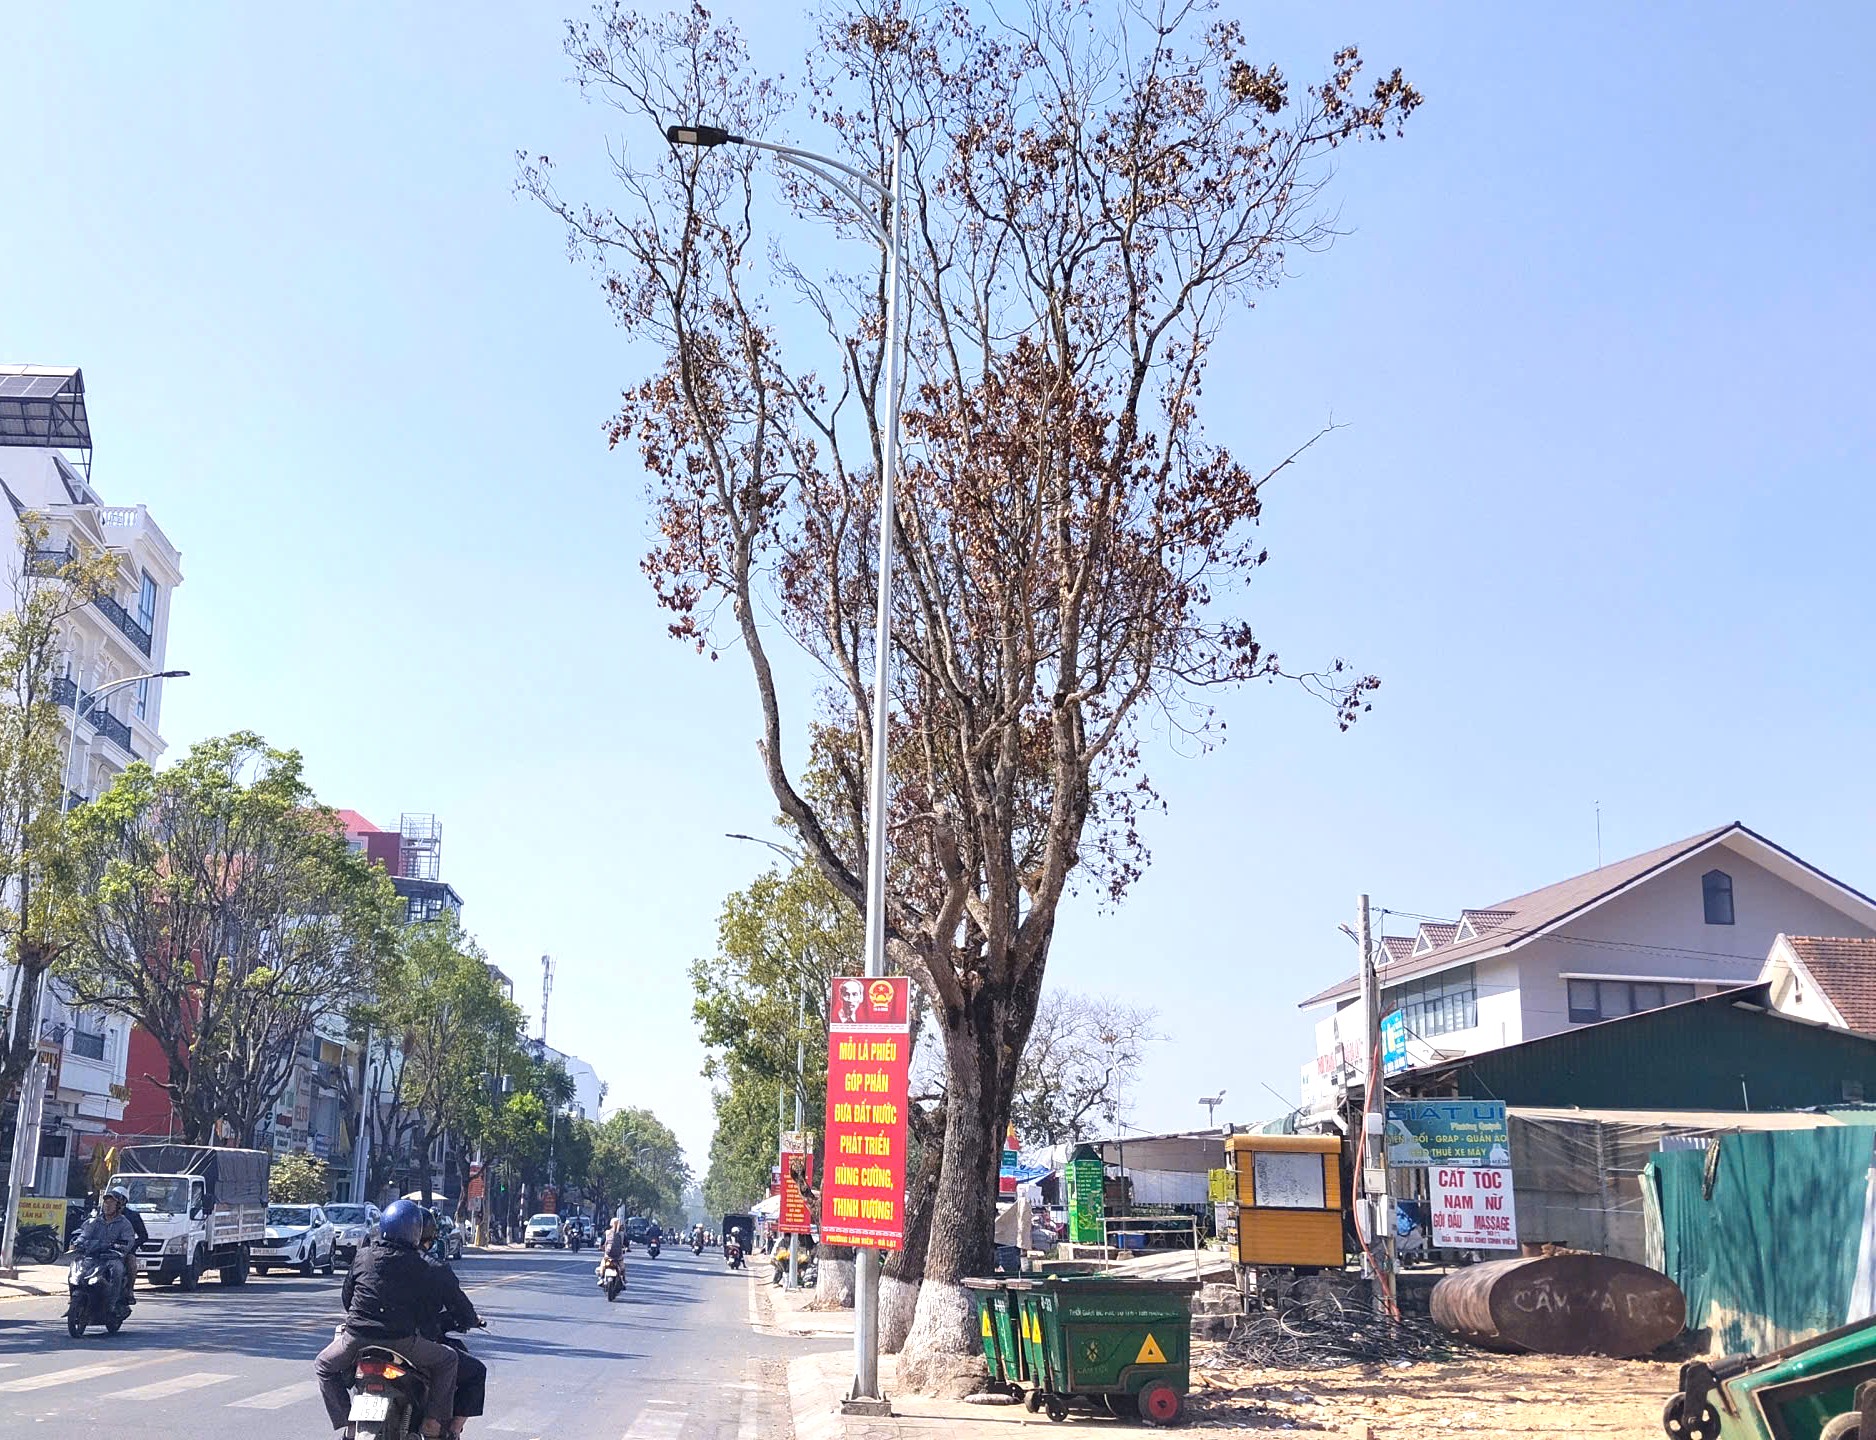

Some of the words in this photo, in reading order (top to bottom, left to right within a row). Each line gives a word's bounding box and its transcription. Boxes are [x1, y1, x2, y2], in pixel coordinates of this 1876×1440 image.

[858, 1039, 869, 1061] LÁ
[871, 1037, 897, 1062] PHIẾU
[845, 1069, 863, 1092] GÓP
[854, 1098, 871, 1124] ĐẤT
[873, 1102, 897, 1125] NƯỚC
[840, 1132, 862, 1154] PHÁT
[864, 1130, 890, 1156] TRIỂN
[1435, 1134, 1460, 1143] GRAP
[1454, 1148, 1466, 1157] XE
[835, 1164, 859, 1186] HÙNG
[1438, 1167, 1466, 1188] CẮT
[1472, 1168, 1503, 1189] TÓC
[1444, 1195, 1474, 1210] NAM
[1485, 1193, 1504, 1211] NỮ
[1474, 1215, 1510, 1231] MASSAGE
